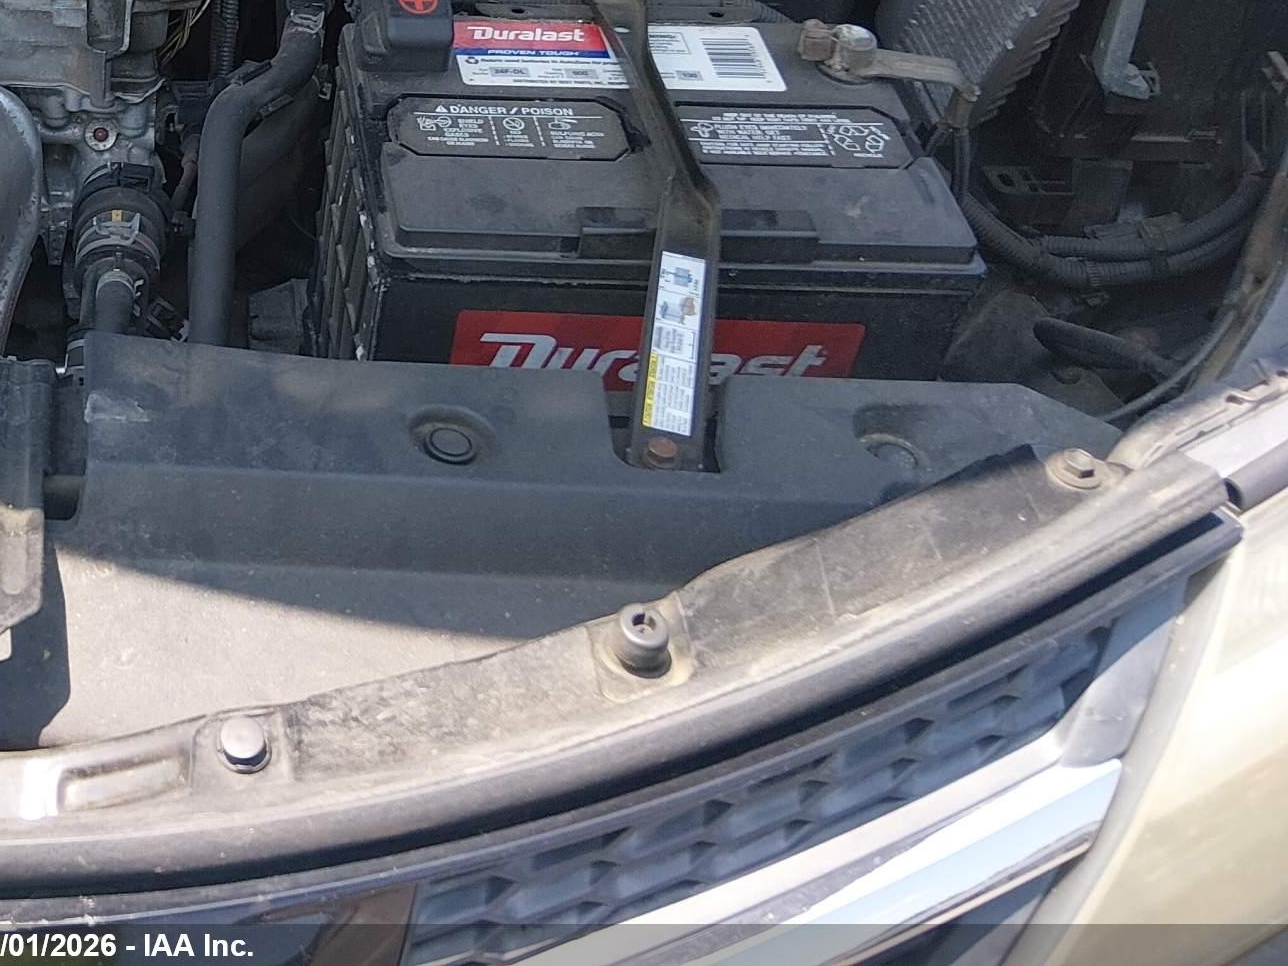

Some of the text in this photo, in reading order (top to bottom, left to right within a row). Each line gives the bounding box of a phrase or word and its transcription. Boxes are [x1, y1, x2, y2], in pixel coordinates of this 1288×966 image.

[467, 26, 585, 42] Duralast
[449, 105, 507, 115] DANGER
[521, 107, 574, 116] POISON
